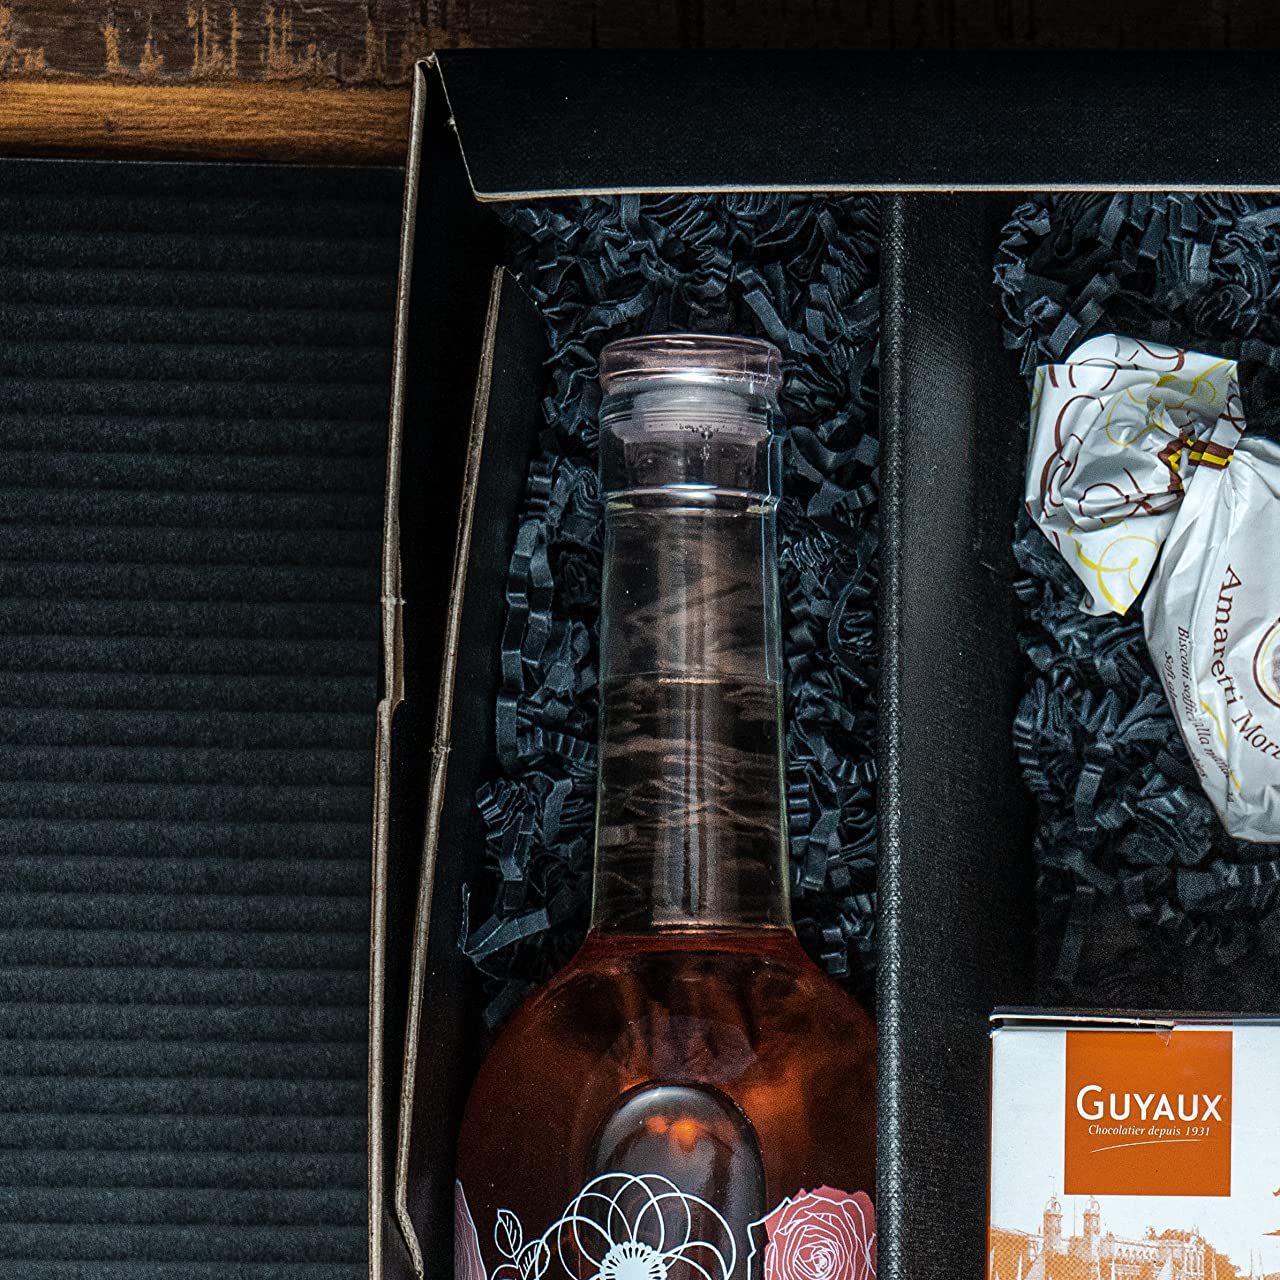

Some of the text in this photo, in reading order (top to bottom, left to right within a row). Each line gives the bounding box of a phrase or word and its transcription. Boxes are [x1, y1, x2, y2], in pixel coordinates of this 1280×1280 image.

[1177, 626, 1190, 680] Biscotti
[1210, 564, 1244, 706] Amaretti
[1088, 1124, 1211, 1138] Chocolatier depuis 1931
